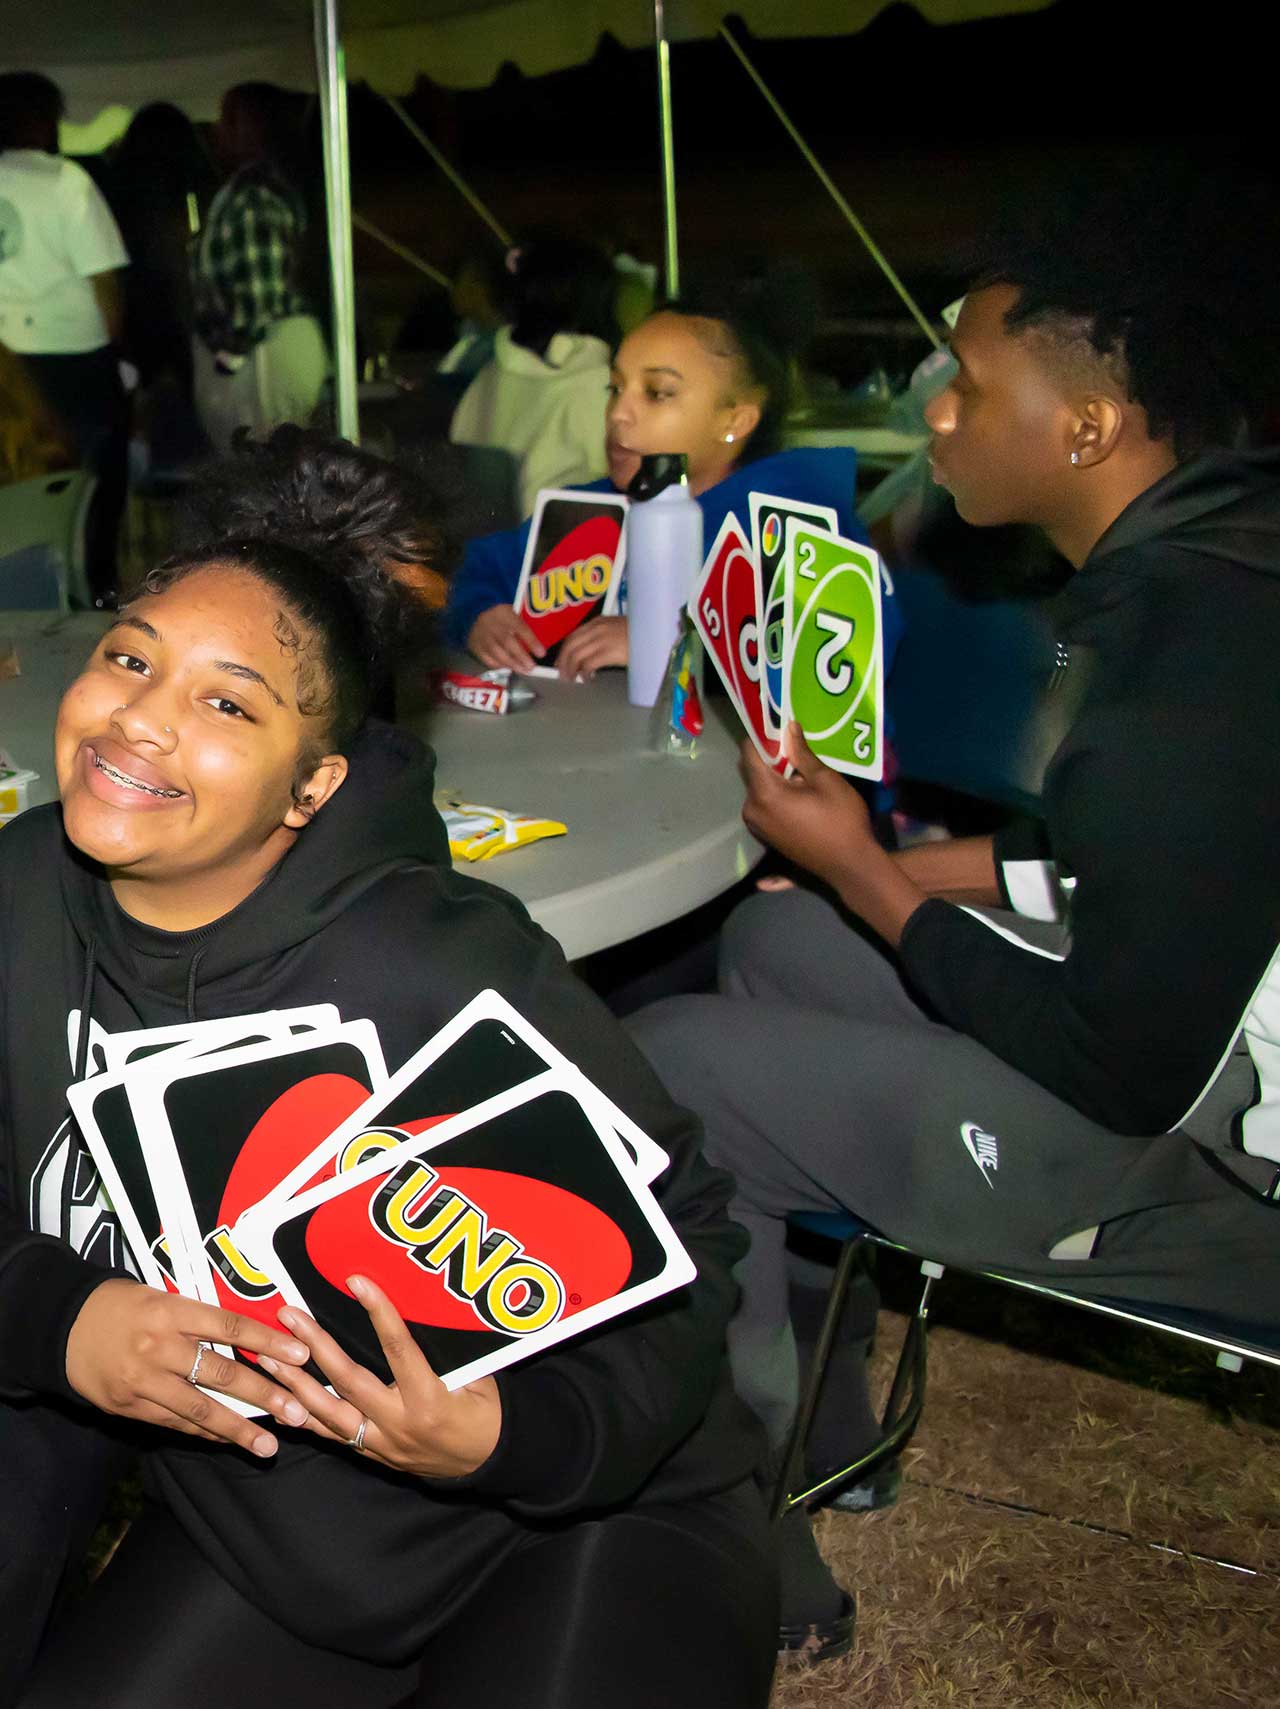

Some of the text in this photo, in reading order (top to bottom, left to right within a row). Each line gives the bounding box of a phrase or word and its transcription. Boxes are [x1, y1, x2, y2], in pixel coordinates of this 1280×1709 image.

[799, 542, 817, 580] 2
[525, 553, 613, 617] UNO
[702, 598, 721, 638] 5
[815, 610, 853, 694] 2
[853, 720, 871, 759] 2
[974, 1131, 998, 1171] NIKE
[369, 1158, 566, 1338] UNO
